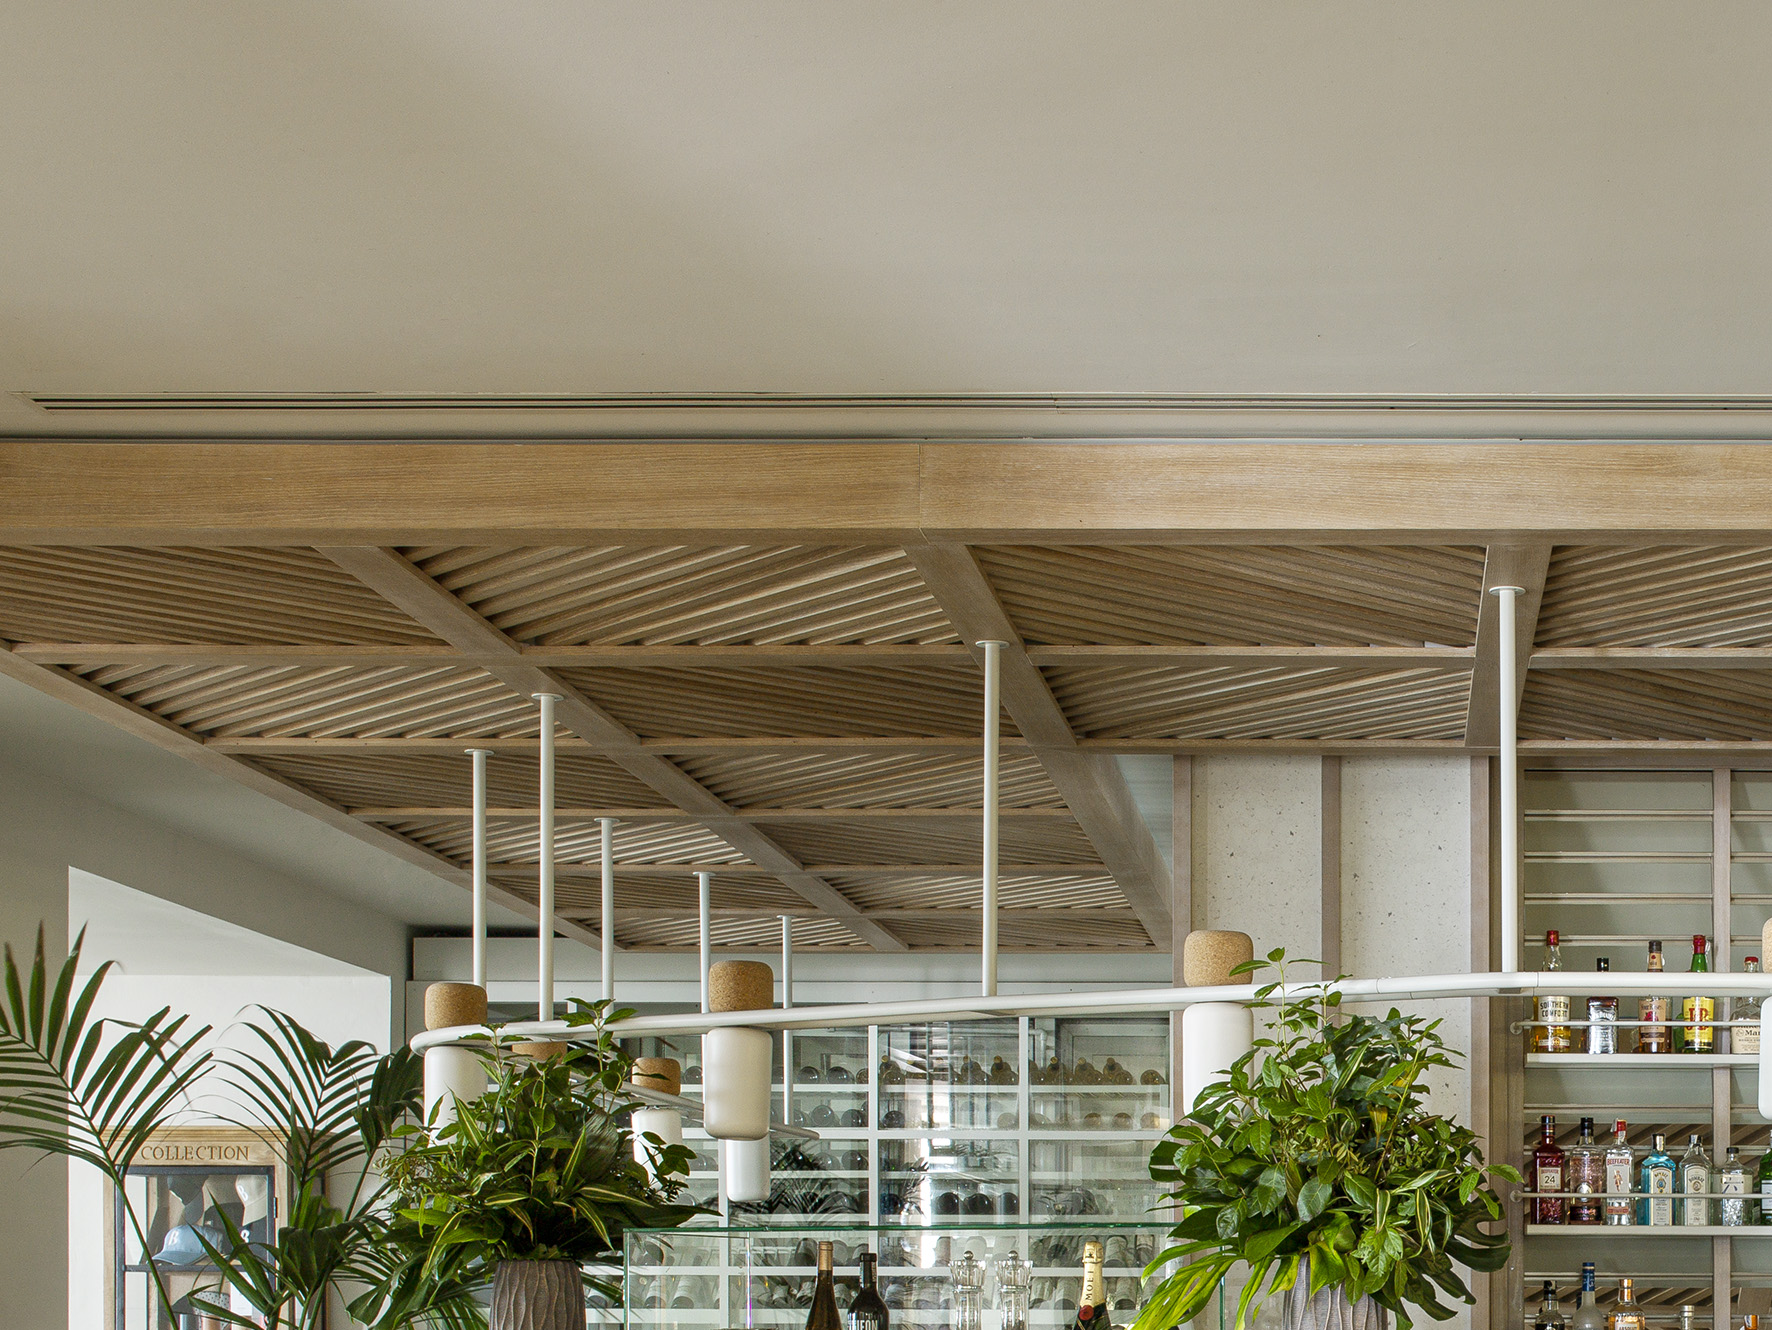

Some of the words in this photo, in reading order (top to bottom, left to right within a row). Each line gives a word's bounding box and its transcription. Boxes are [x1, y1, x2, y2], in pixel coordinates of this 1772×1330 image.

[1540, 1001, 1568, 1009] SOUTHERN
[1541, 1010, 1567, 1018] COMFORT
[141, 1145, 250, 1161] COLLECTION
[1544, 1175, 1555, 1183] 24
[238, 1185, 249, 1201] B
[168, 1230, 179, 1246] B
